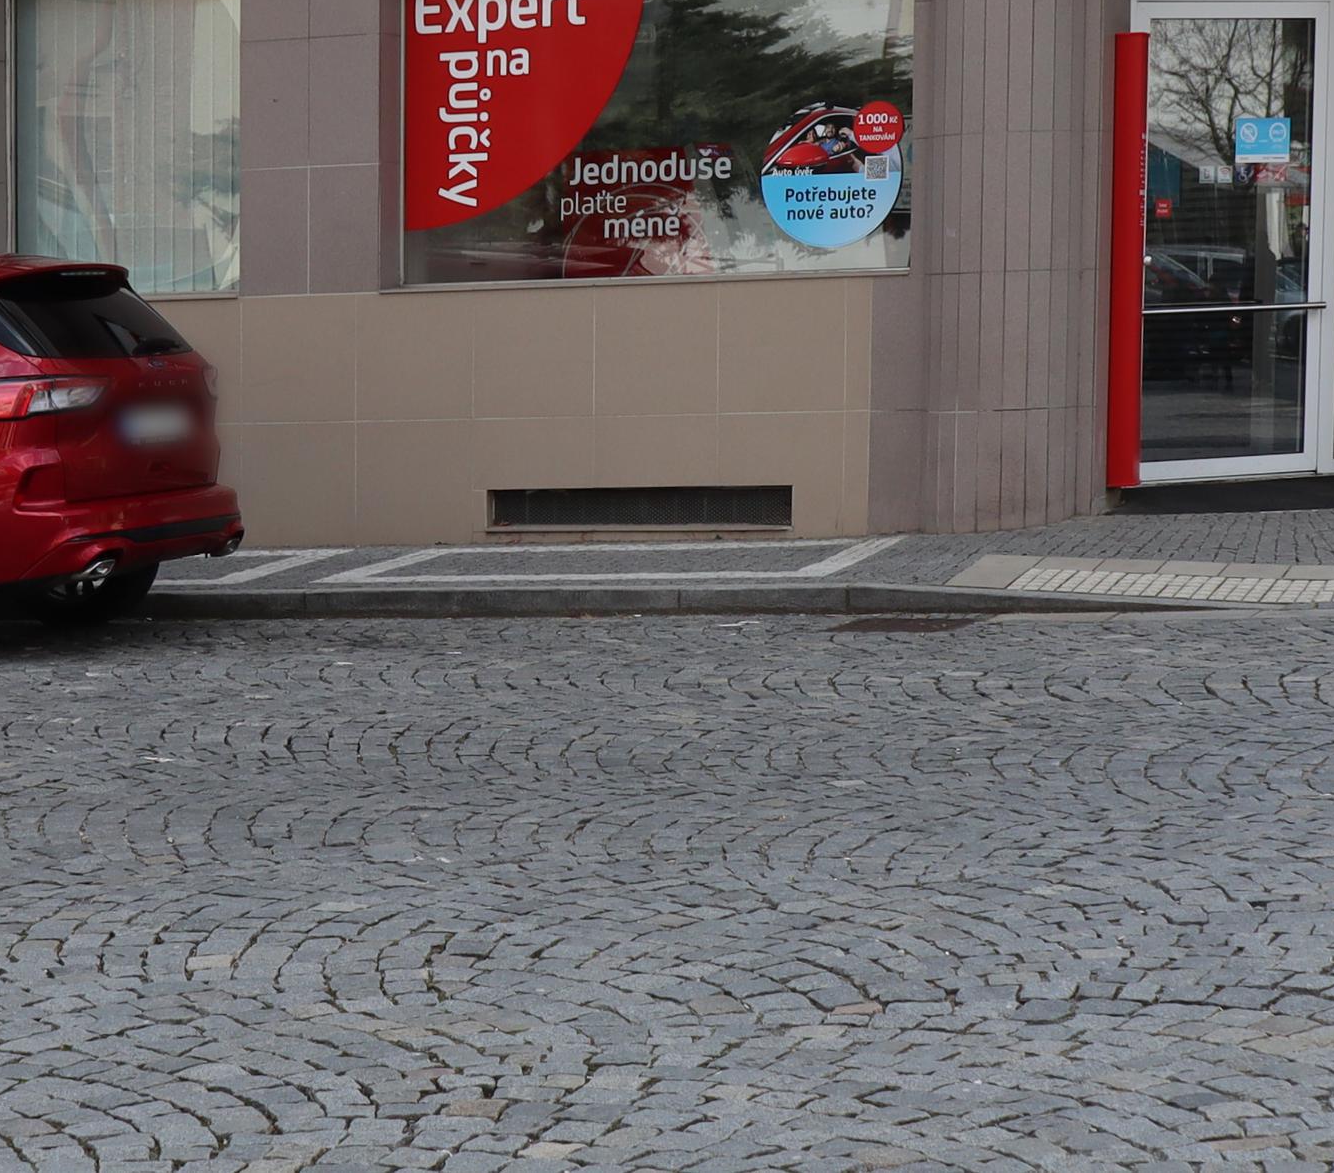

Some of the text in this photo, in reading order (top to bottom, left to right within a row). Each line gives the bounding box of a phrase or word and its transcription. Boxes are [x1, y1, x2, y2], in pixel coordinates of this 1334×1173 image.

[486, 48, 530, 77] na
[438, 51, 492, 207] půjčky
[569, 148, 732, 185] Jednoduše
[560, 190, 627, 221] plaťte
[785, 187, 876, 204] Potřebujete
[604, 207, 680, 239] méně
[786, 204, 874, 220] nové auto?
